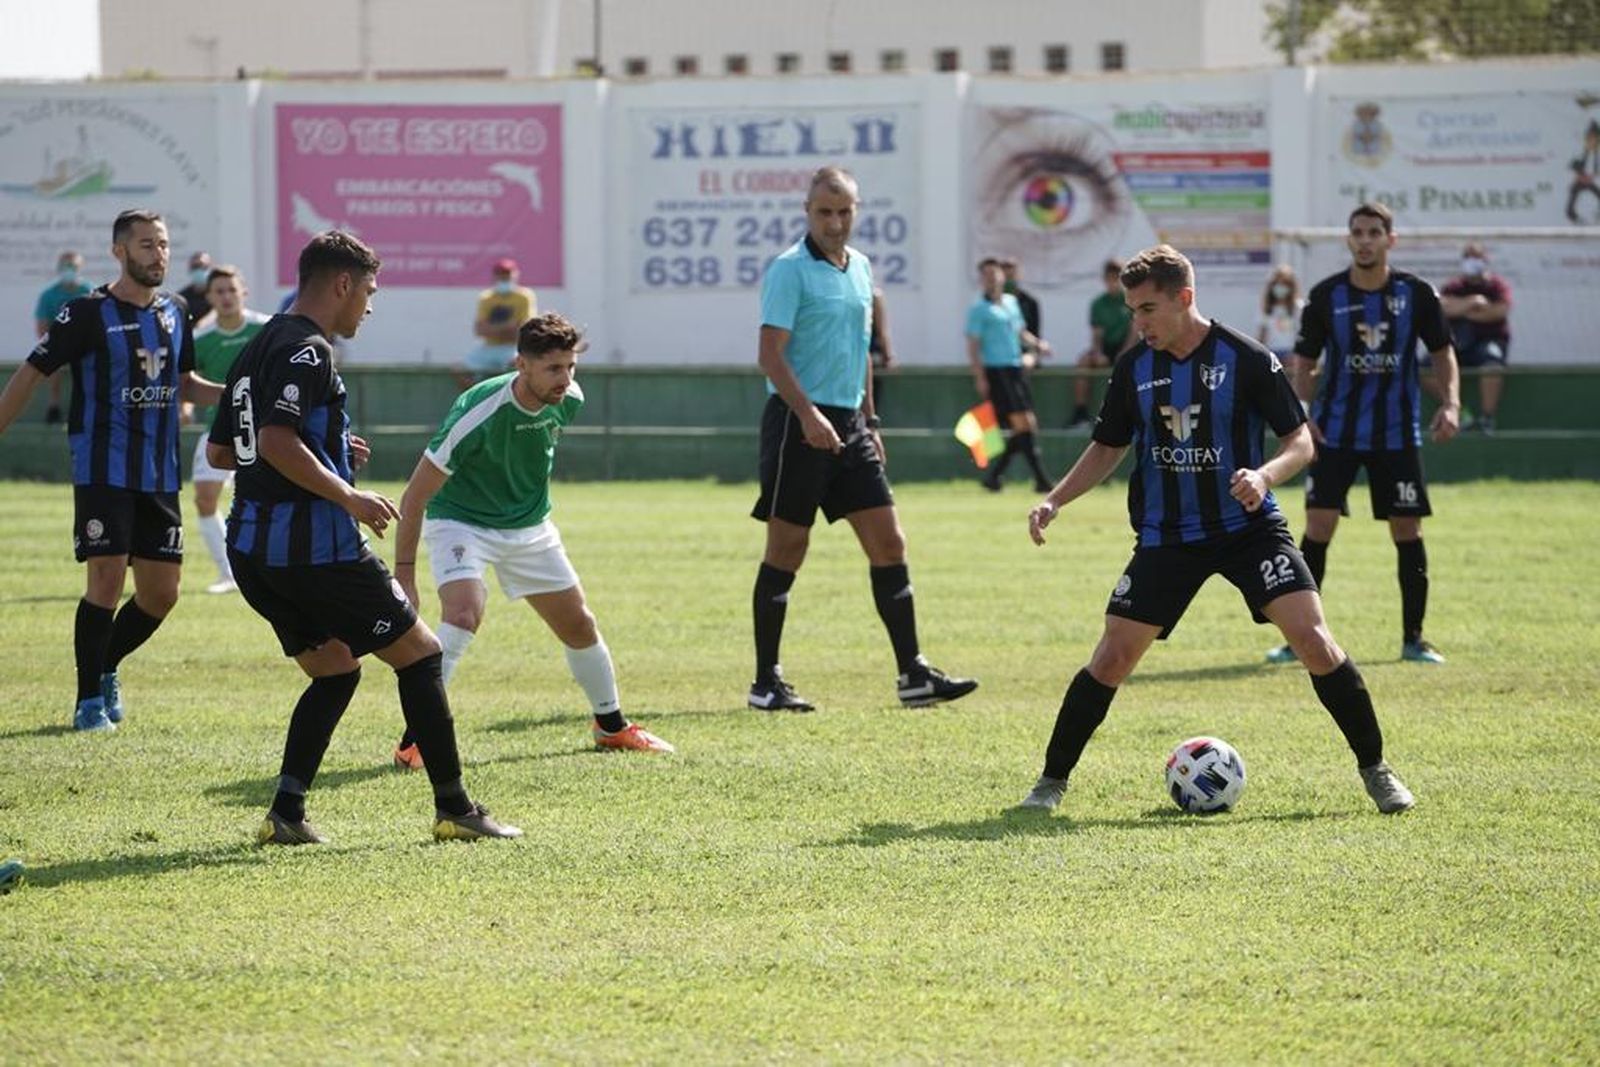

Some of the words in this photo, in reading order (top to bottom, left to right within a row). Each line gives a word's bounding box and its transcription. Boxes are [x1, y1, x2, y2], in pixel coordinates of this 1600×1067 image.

[291, 118, 347, 154] YO
[349, 118, 400, 154] TE
[404, 118, 547, 155] ESPERO
[699, 169, 723, 194] EL
[643, 218, 718, 248] 637
[643, 256, 722, 287] 638
[232, 376, 258, 466] 3
[1151, 446, 1223, 466] FOOTFAY
[1396, 481, 1418, 502] 16
[1259, 554, 1296, 584] 22
